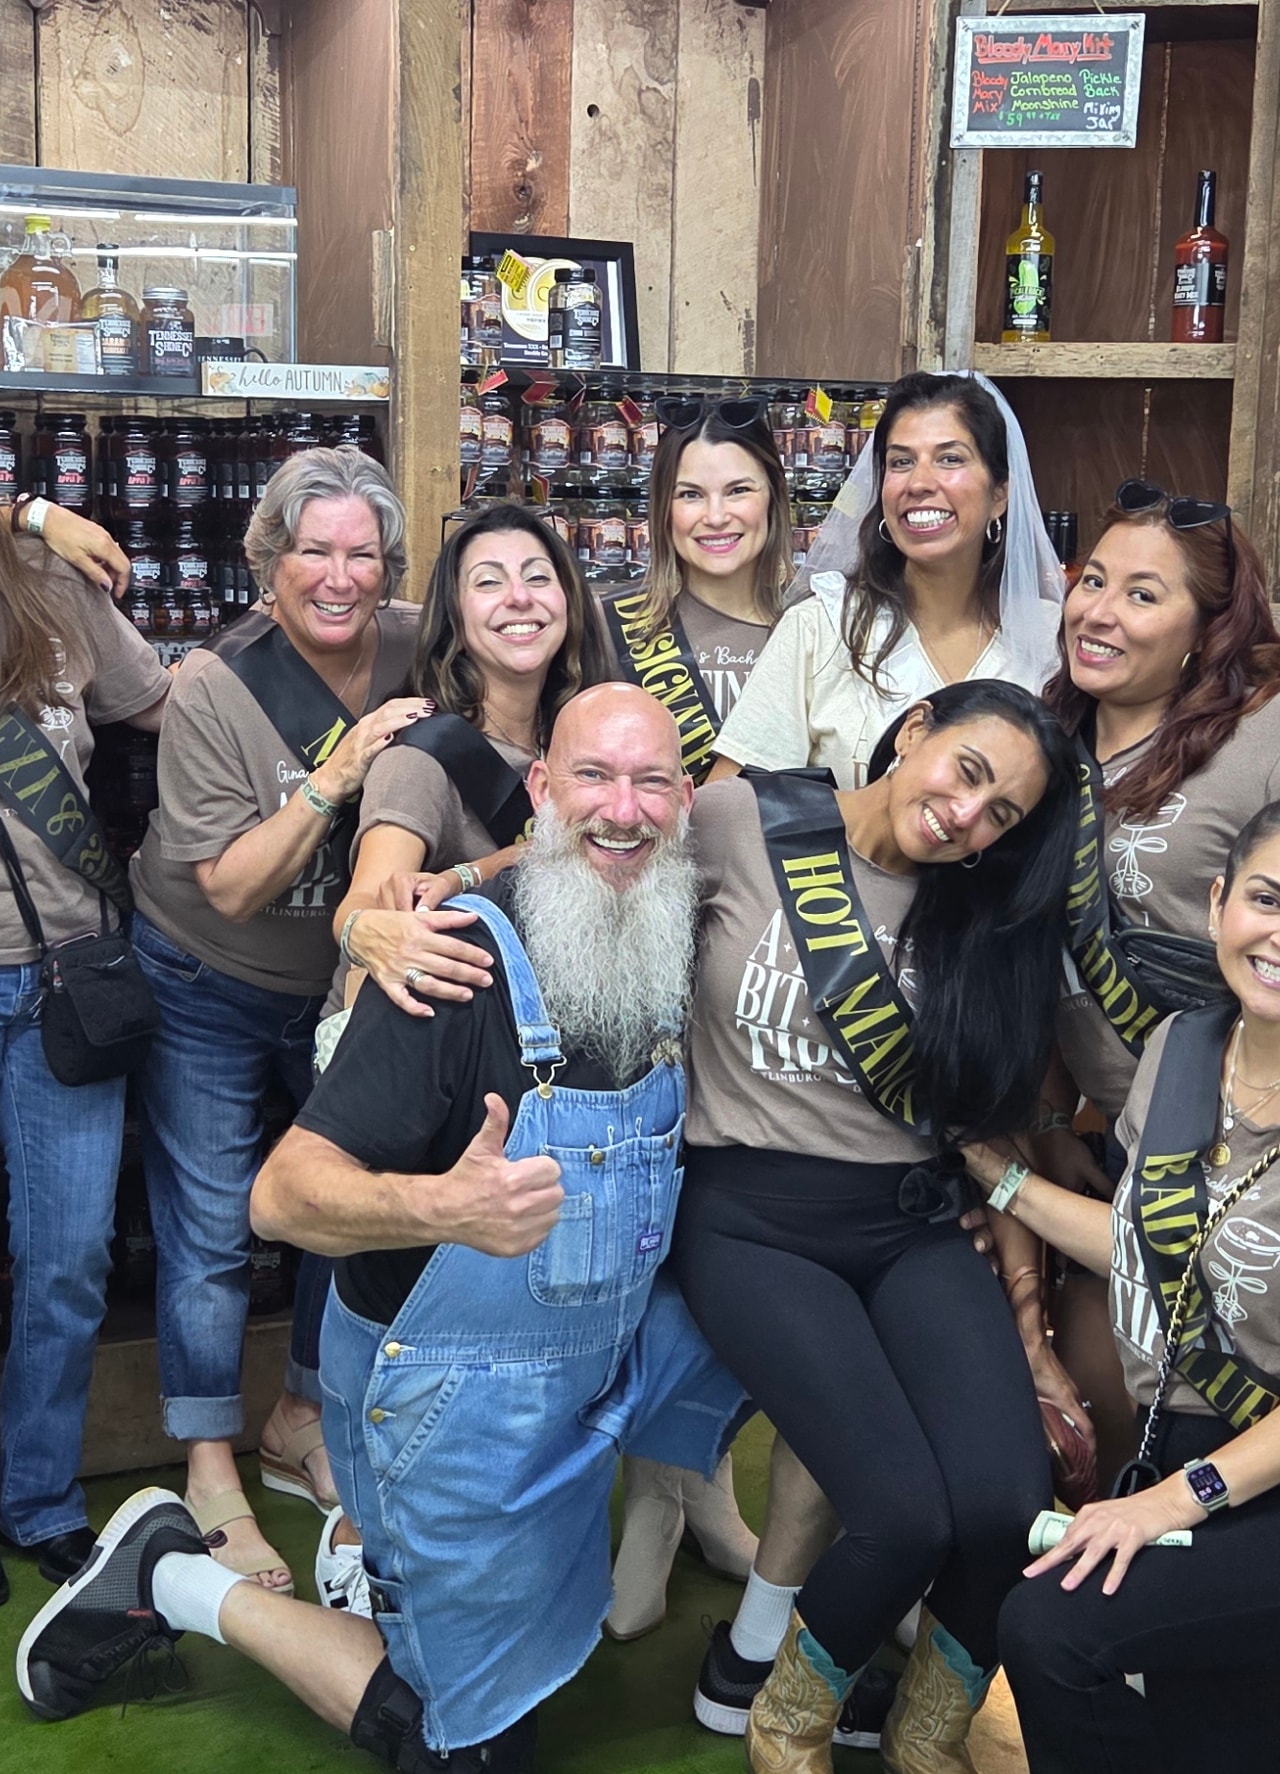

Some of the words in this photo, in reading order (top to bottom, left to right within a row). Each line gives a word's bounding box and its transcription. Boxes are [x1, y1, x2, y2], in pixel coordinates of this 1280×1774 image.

[974, 34, 1032, 64] Bloody
[1034, 33, 1082, 64] Mary
[971, 71, 1008, 88] Bloody
[1010, 71, 1073, 90] Jalapeno
[1078, 68, 1122, 84] Pickle
[1010, 84, 1078, 97] Cornbread
[1083, 84, 1120, 97] Back
[973, 101, 1000, 113] Mix
[1011, 98, 1080, 111] Moonshine
[237, 366, 283, 388] hello
[285, 371, 343, 393] AUTUMN
[781, 850, 869, 957] HOT
[735, 960, 809, 1032] BIT
[1140, 1150, 1201, 1257] BAD
